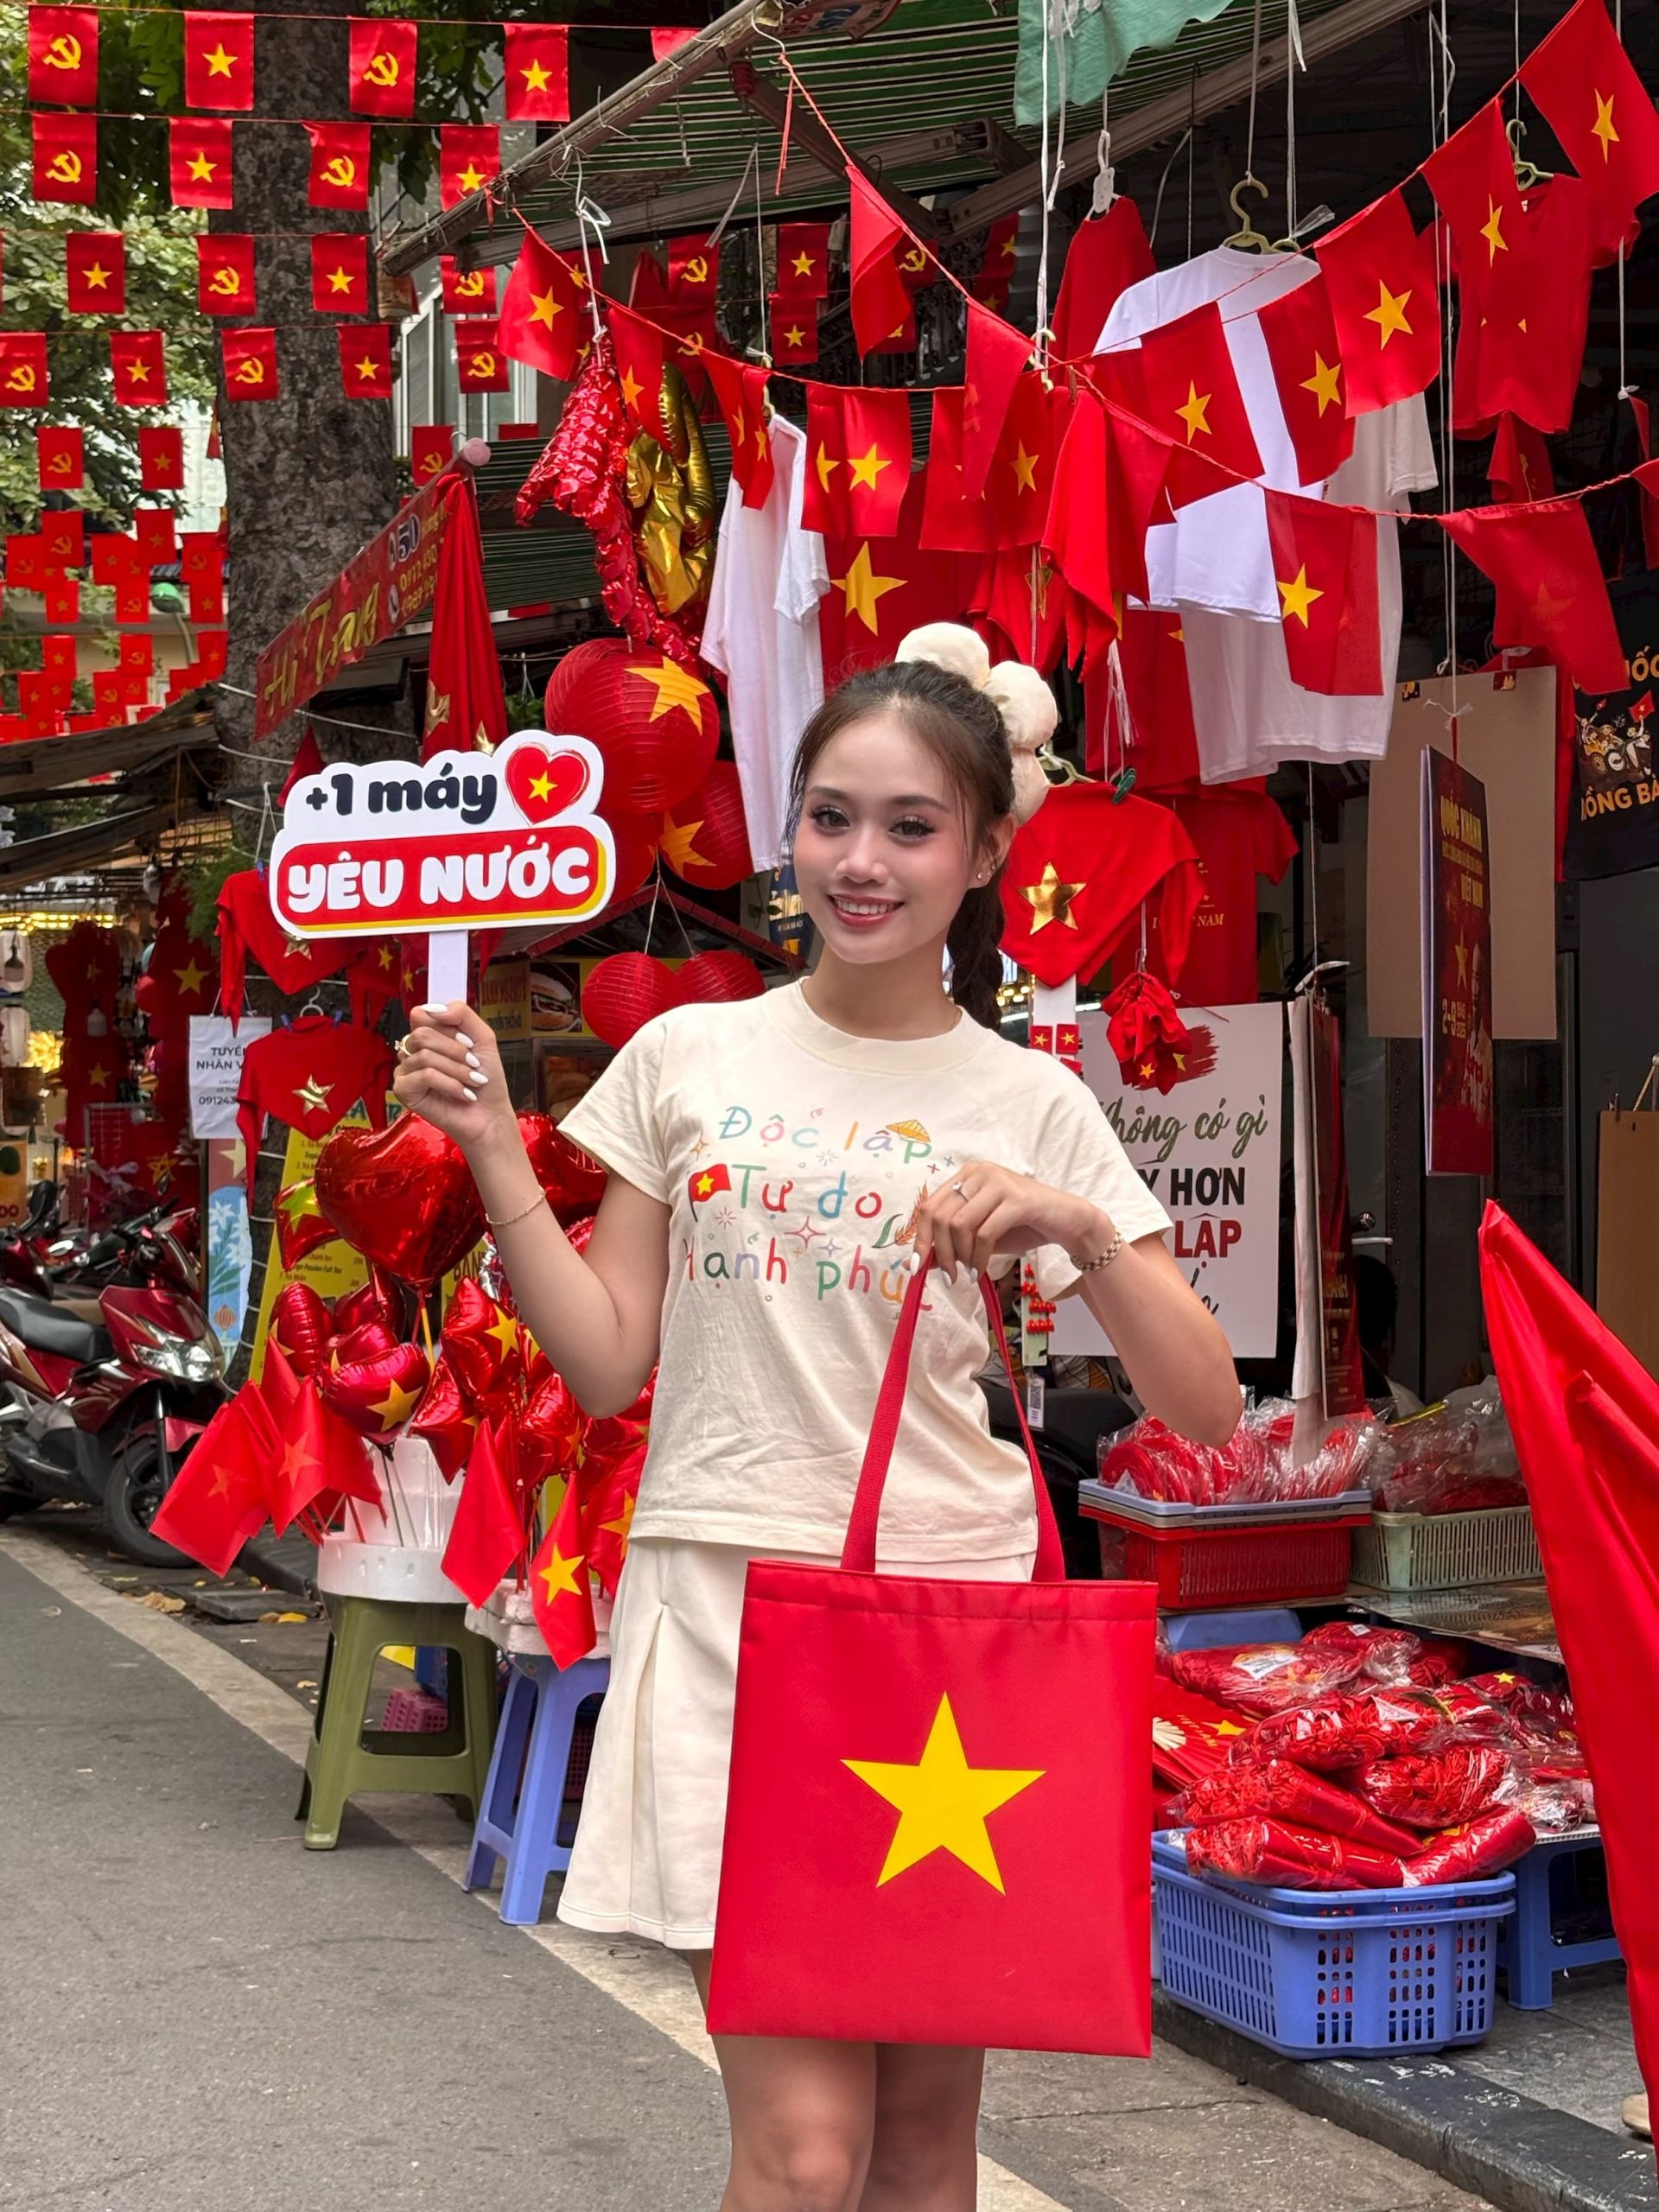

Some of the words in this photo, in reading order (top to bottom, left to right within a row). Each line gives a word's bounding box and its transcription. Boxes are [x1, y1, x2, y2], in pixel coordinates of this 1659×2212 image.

[305, 772, 353, 816] +1
[367, 762, 497, 824] máy
[287, 850, 404, 913] YÊU
[419, 834, 591, 905] NƯỚC
[1196, 913, 1225, 927] NAM
[719, 1105, 820, 1149] Độc
[1194, 1098, 1232, 1141] có
[1232, 1094, 1269, 1159] gì
[731, 1164, 794, 1221] Tự
[817, 1170, 882, 1219] do
[1170, 1166, 1245, 1206] HƠN
[1175, 1212, 1243, 1268] LẬP
[815, 1244, 933, 1311] phú
